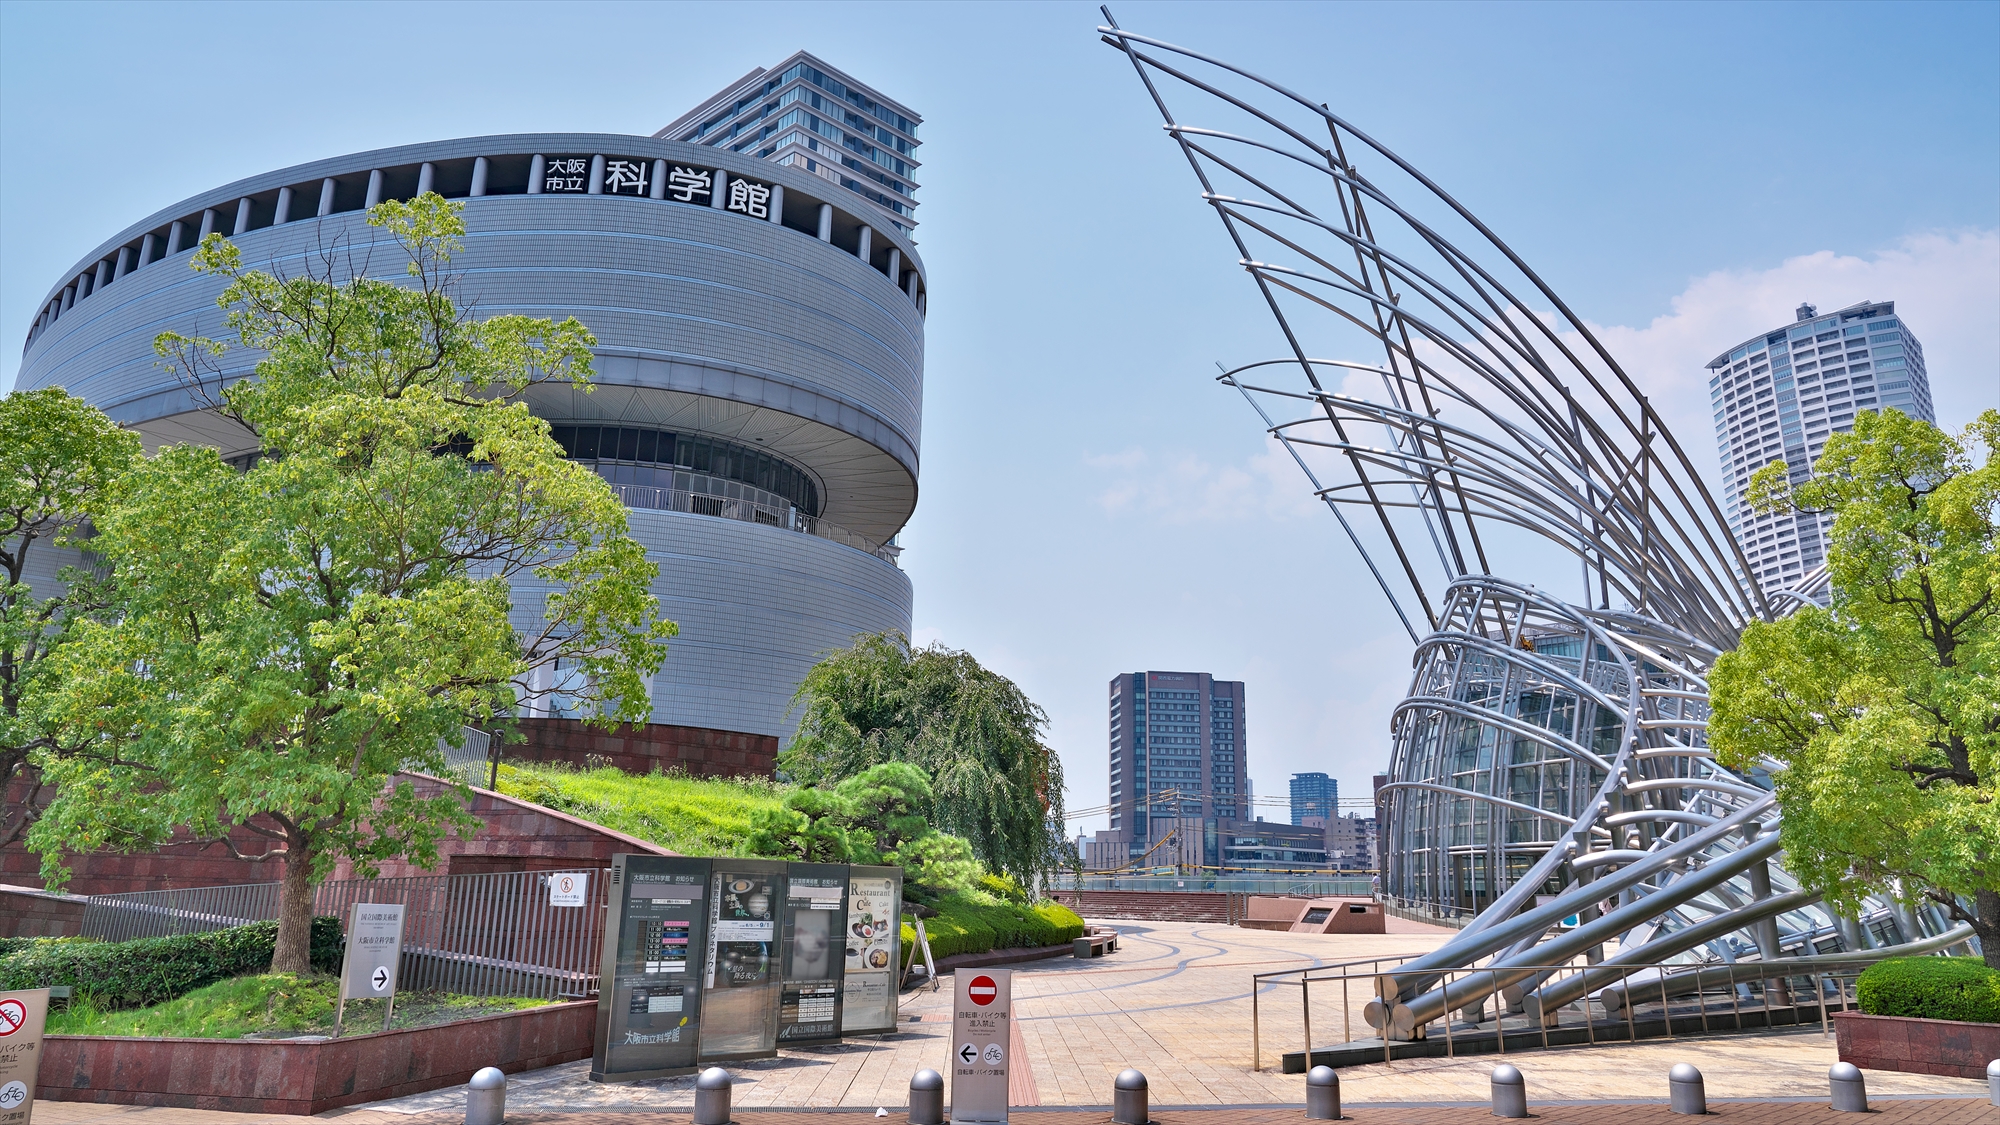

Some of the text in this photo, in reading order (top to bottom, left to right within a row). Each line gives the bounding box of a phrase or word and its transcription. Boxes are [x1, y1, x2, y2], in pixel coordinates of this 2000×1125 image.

[547, 158, 587, 175] 大阪
[546, 176, 584, 192] 市立
[850, 882, 891, 897] Restaurant
[358, 936, 395, 944] 大阪市立科学館
[707, 926, 717, 975] プラネタリウム
[624, 1026, 681, 1045] 大阪市立科学館
